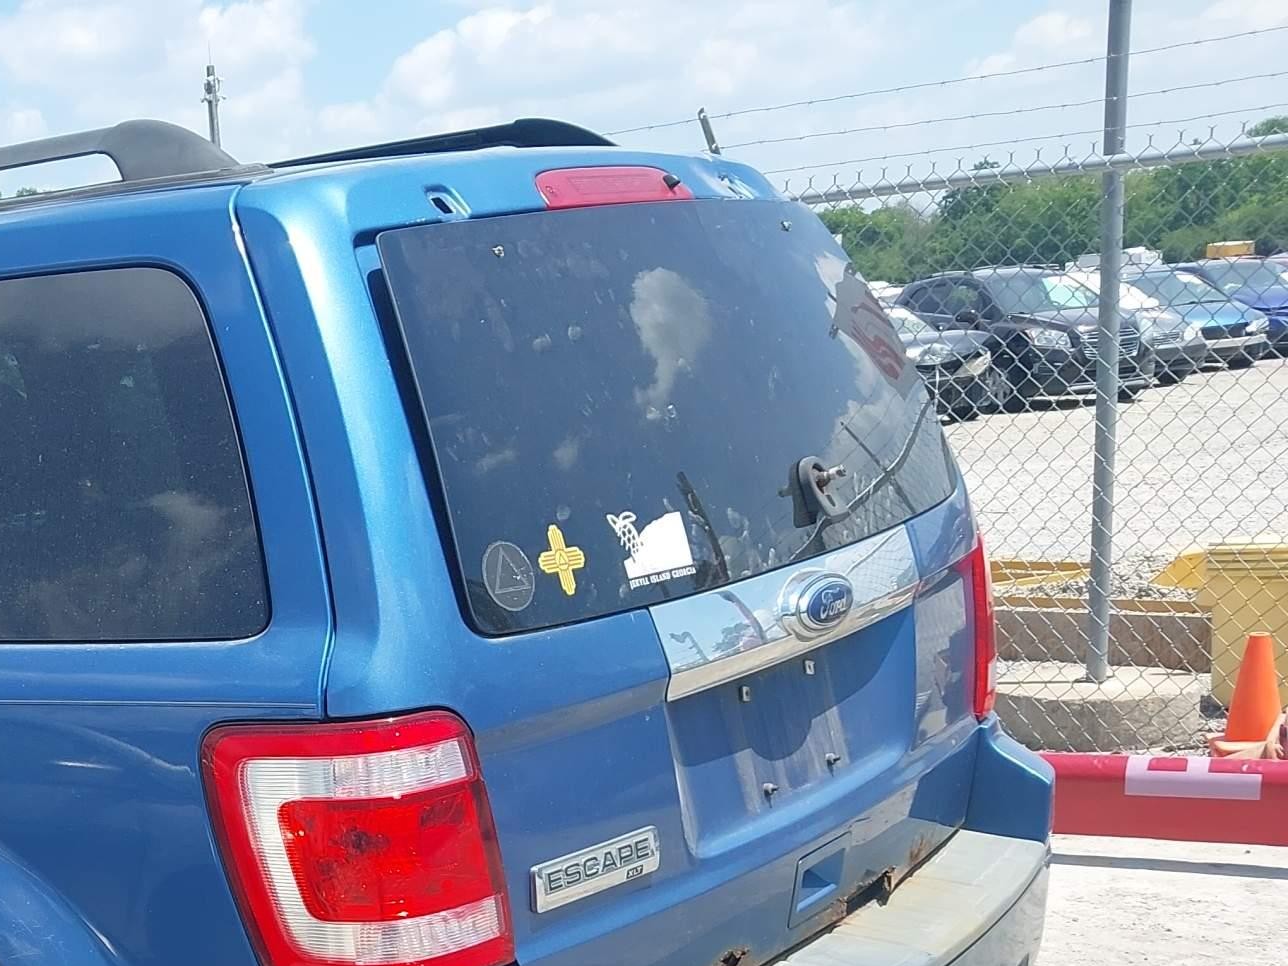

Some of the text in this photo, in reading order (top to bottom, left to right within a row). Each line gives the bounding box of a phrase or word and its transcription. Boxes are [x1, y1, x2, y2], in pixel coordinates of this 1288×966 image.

[820, 588, 847, 619] Ford
[546, 837, 652, 892] ESCAPE
[627, 865, 643, 879] XLT
